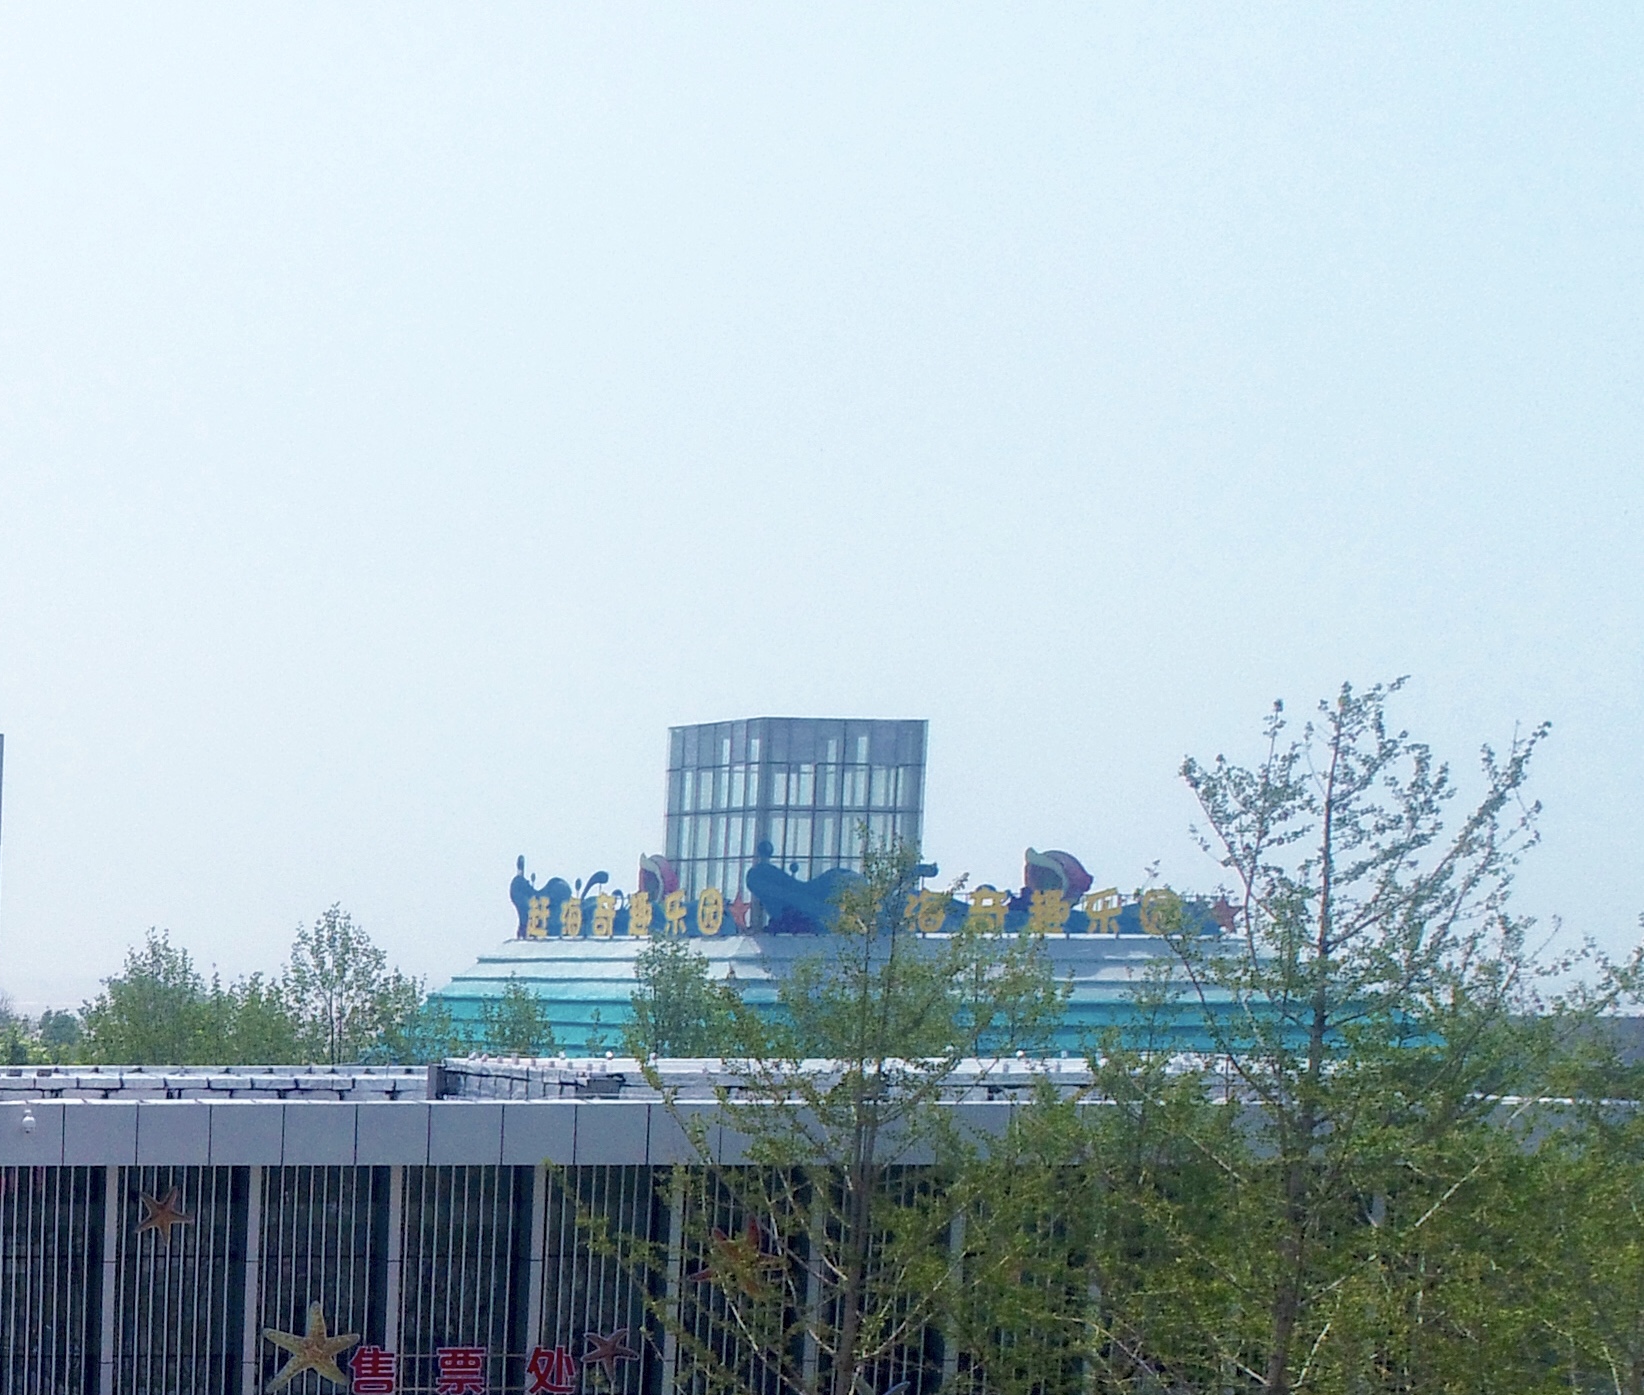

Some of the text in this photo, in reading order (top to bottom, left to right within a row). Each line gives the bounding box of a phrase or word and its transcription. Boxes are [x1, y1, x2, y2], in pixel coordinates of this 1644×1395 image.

[837, 886, 1182, 937] 海奇趣乐园
[348, 1345, 578, 1395] 售票处
